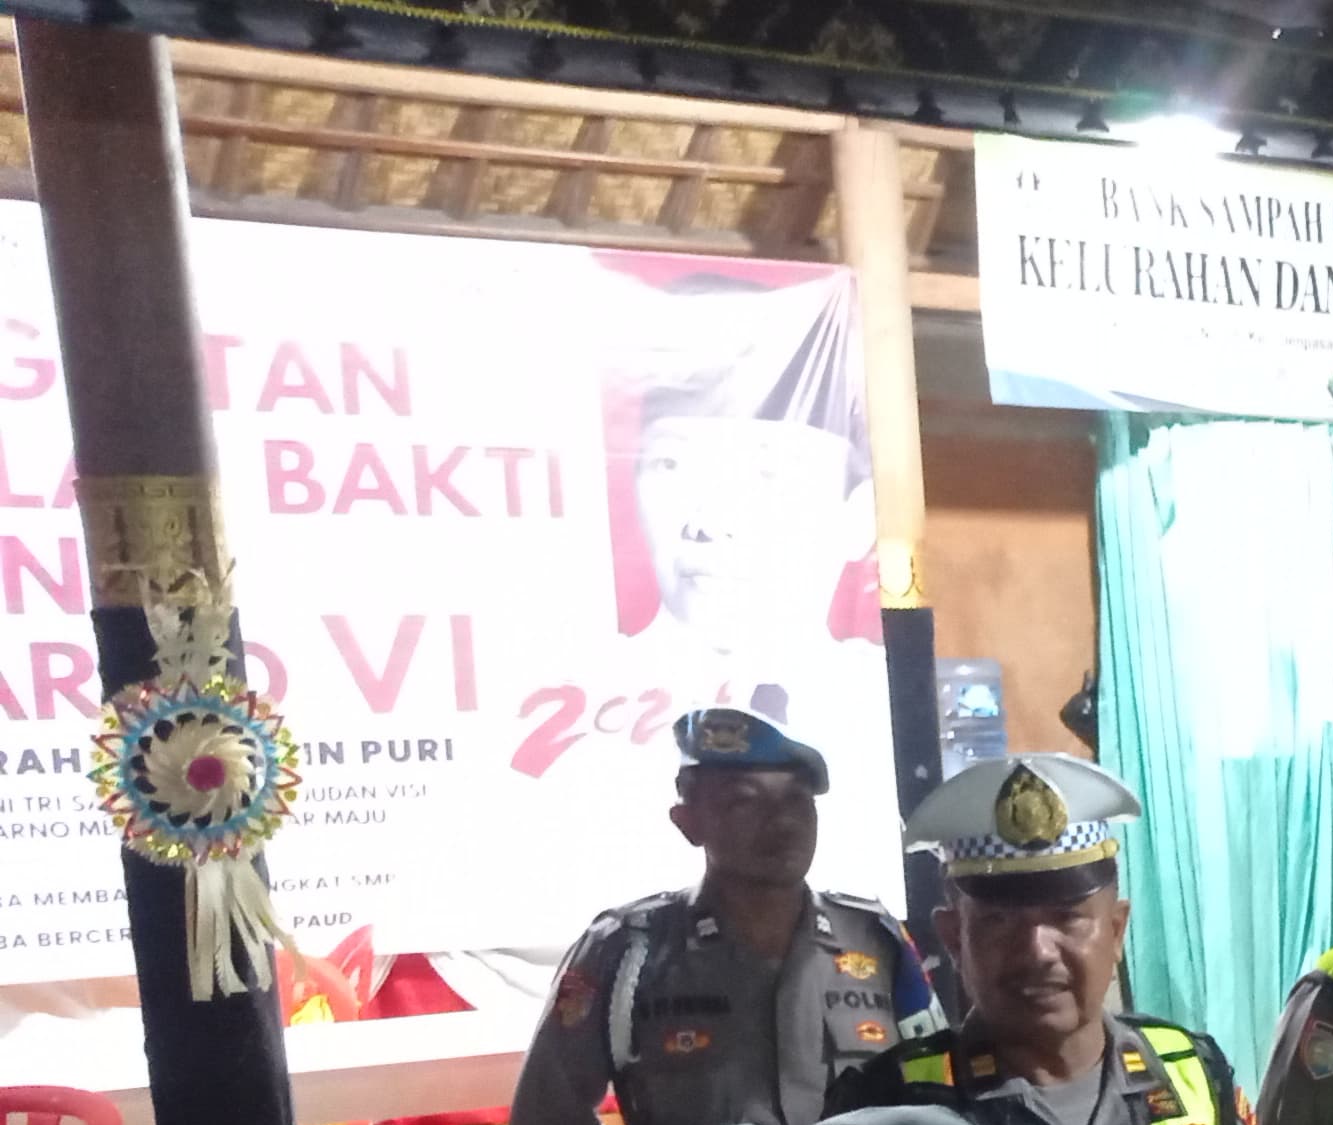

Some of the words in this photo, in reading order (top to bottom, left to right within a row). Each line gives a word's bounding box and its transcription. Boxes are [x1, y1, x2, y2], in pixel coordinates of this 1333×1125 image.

[1017, 234, 1262, 307] KELURAHAN
[263, 438, 566, 518] BAKTI
[320, 613, 480, 714] VI
[361, 738, 453, 764] PURI
[24, 796, 61, 812] TRI
[387, 783, 427, 798] VISI
[325, 809, 387, 825] MAJU
[33, 888, 127, 907] MEMBA
[38, 927, 132, 947] BERCER
[293, 912, 352, 929] PAUD
